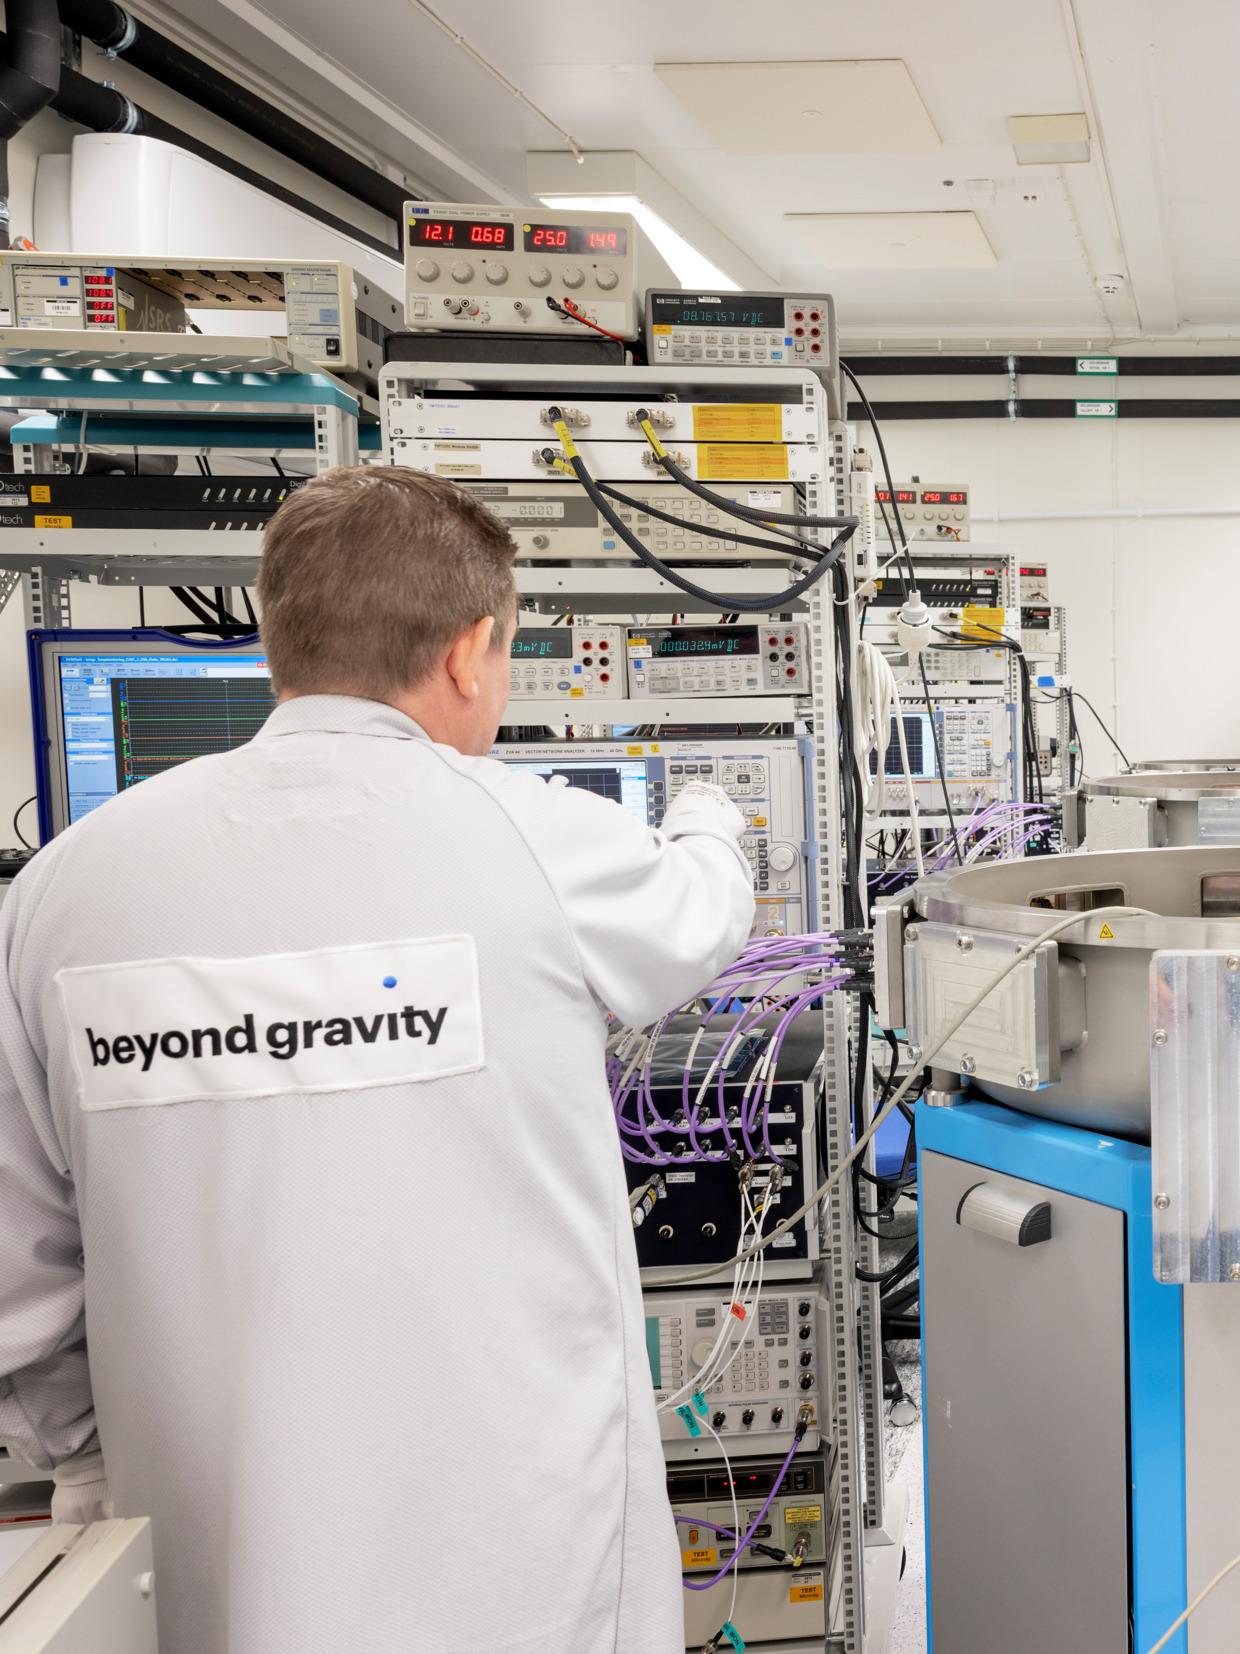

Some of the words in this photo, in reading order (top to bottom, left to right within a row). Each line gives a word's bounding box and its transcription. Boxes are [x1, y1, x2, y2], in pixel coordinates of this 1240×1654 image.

[425, 225, 453, 240] 12.1
[471, 227, 505, 243] 0.68
[534, 230, 567, 246] 25.0
[768, 906, 780, 920] 2
[85, 1013, 257, 1072] beyond
[266, 975, 449, 1060] gravity
